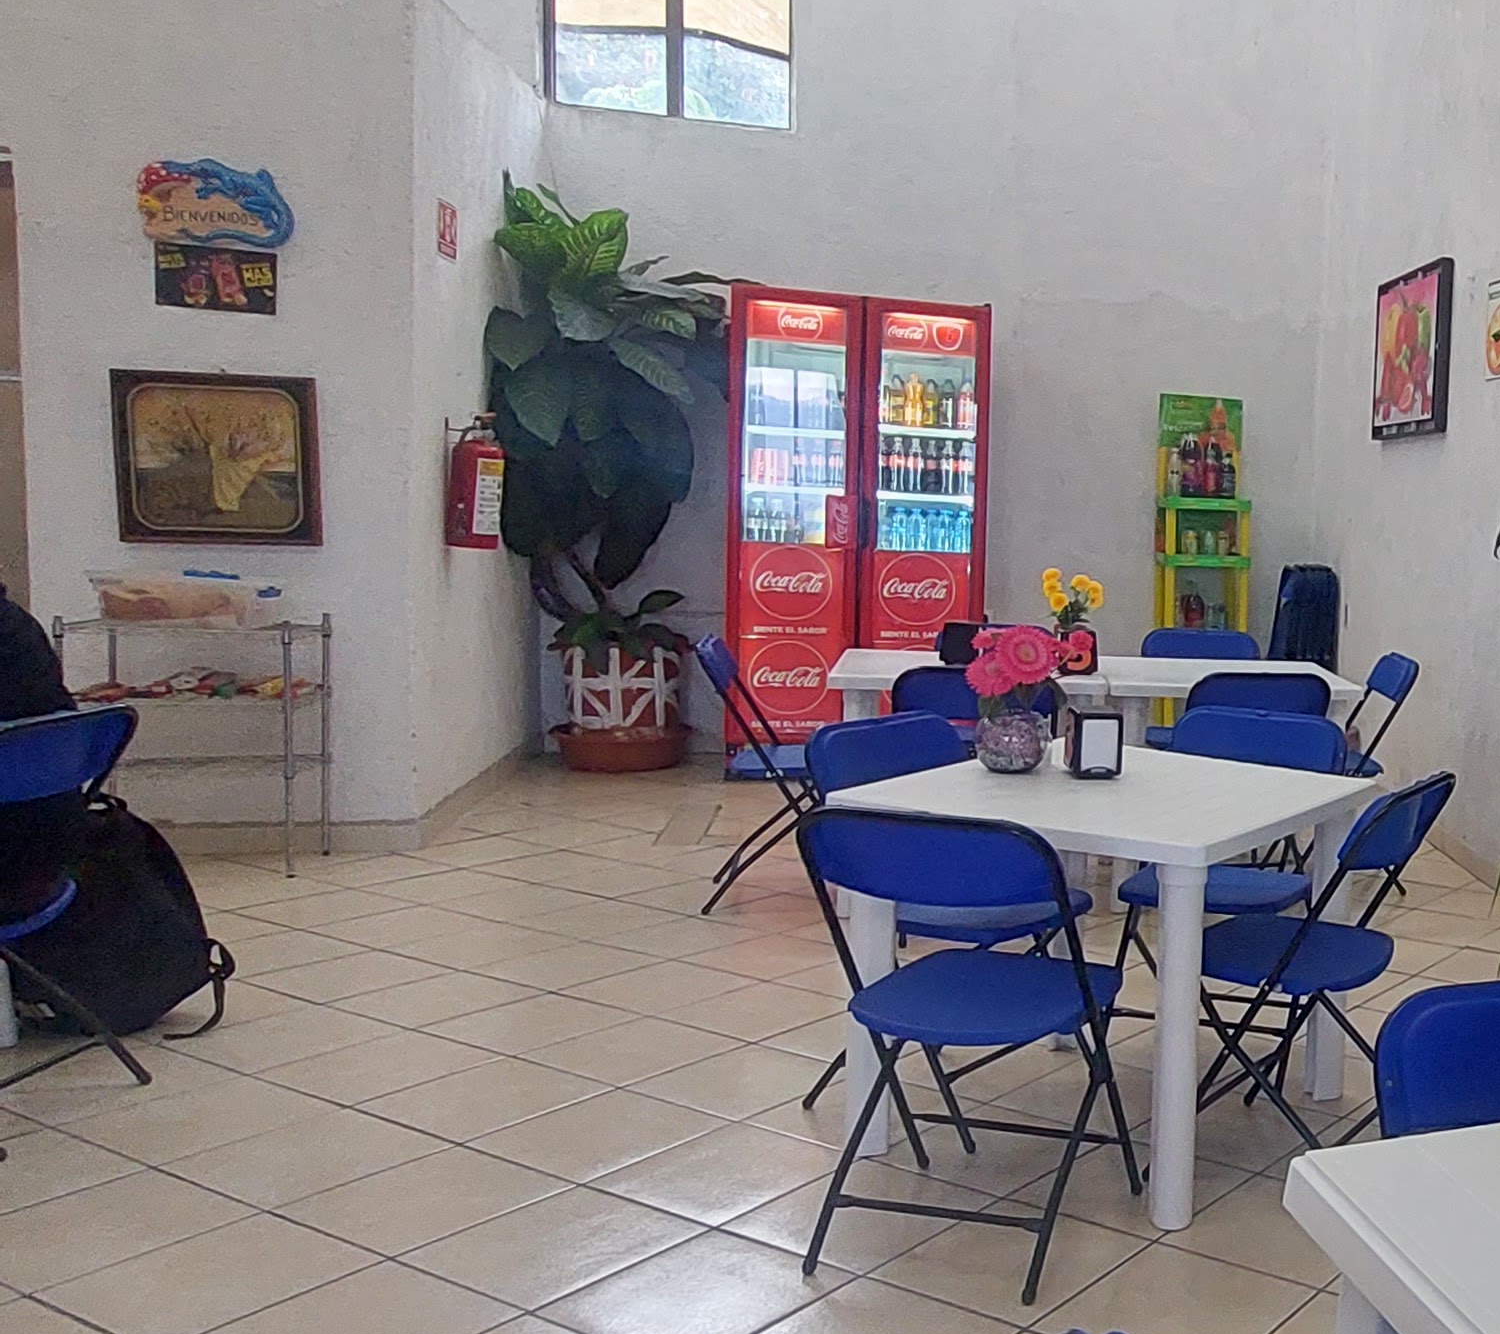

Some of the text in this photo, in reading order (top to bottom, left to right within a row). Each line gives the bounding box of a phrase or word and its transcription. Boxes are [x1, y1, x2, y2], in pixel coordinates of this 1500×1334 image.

[162, 205, 259, 227] BIENVENIDOS
[755, 570, 828, 593] Coca-Cola
[882, 577, 950, 599] Coca-Cola
[922, 631, 939, 639] SAB
[753, 666, 824, 688] Coca-Cola
